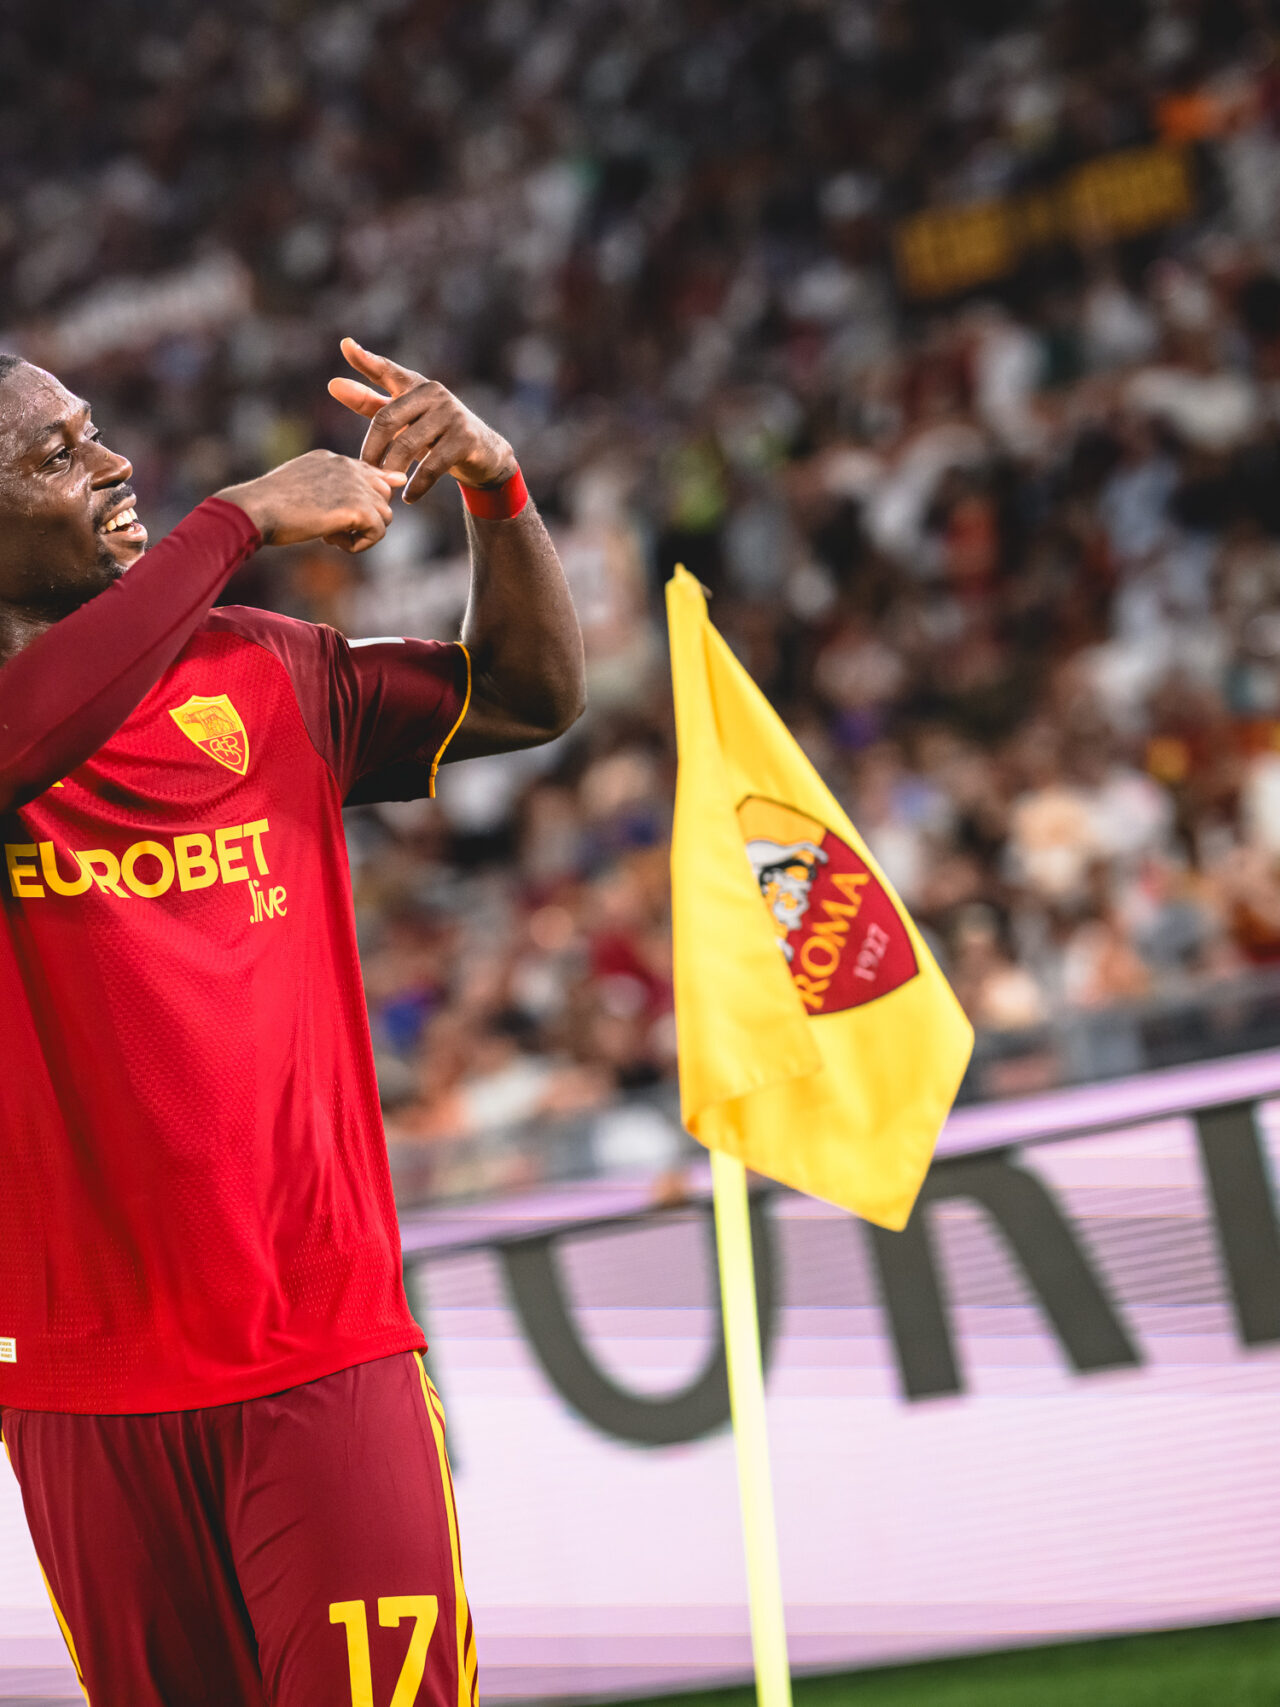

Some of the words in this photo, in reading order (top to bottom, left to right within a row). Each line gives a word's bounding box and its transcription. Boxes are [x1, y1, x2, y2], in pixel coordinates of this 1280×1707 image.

[4, 818, 270, 898] EUROBET
[794, 873, 870, 1009] ROMA
[329, 1595, 439, 1707] 17
